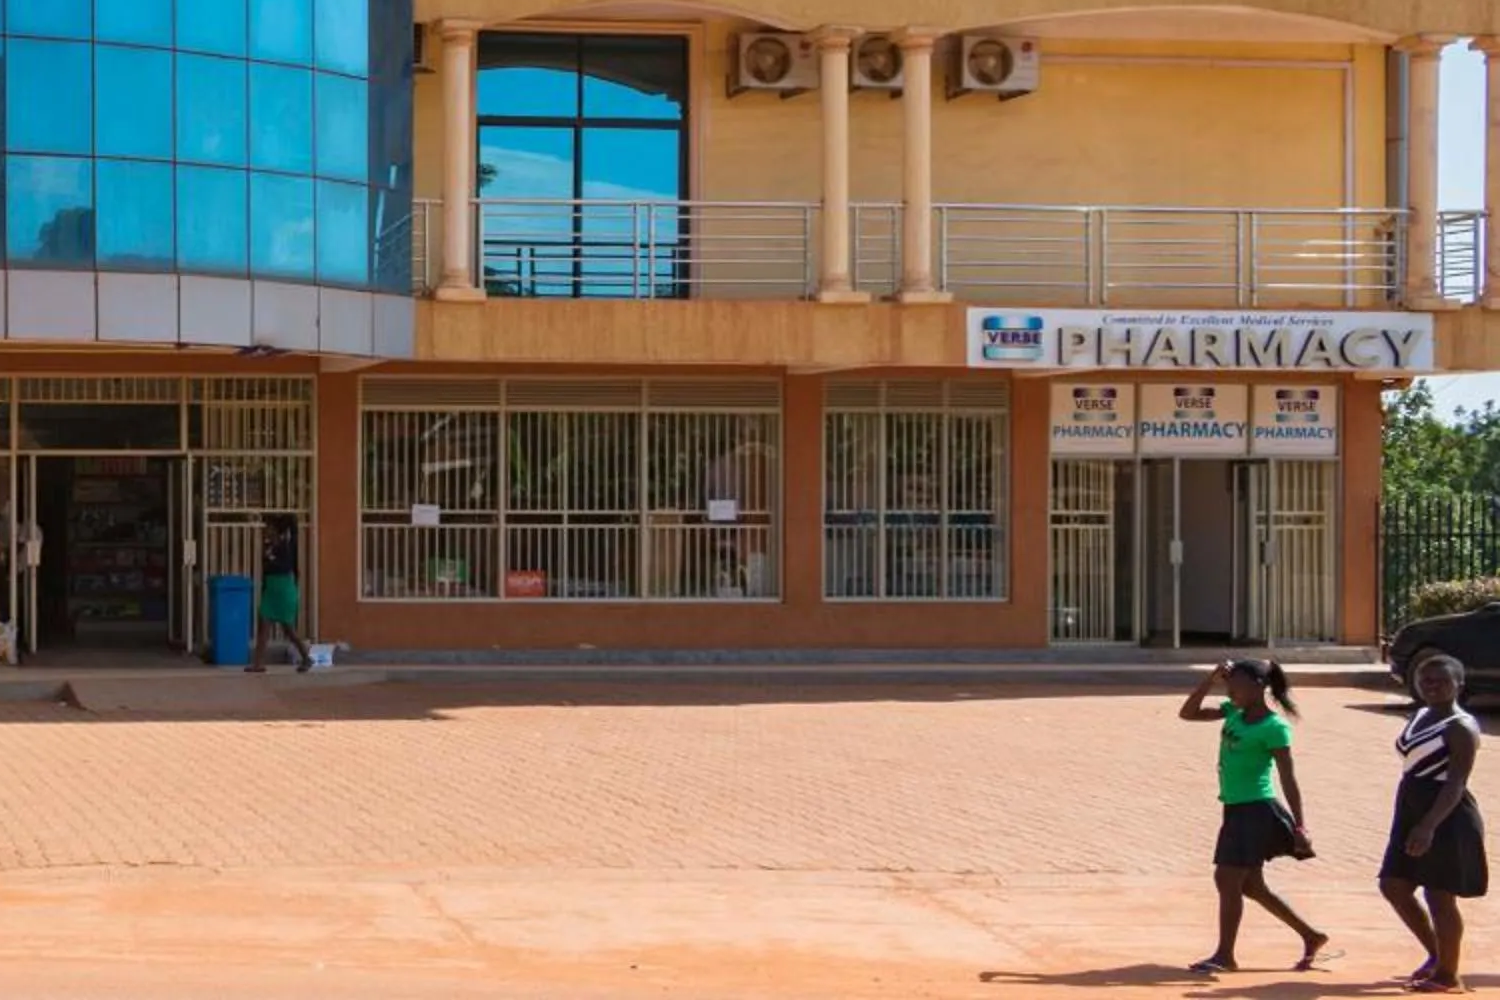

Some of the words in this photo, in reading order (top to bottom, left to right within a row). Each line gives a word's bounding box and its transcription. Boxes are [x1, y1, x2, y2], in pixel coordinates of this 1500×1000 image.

[1181, 315, 1233, 325] Excellent
[1241, 316, 1284, 326] Medical
[1289, 317, 1334, 326] Services
[1057, 327, 1423, 367] PHARMACY
[1075, 400, 1113, 410] VERSE
[1175, 398, 1212, 408] VERSE
[1278, 402, 1316, 412] VERSE
[1053, 425, 1133, 437] PHARMACY
[1141, 422, 1245, 438] PHARMACY
[1255, 426, 1333, 438] PHARMACY
